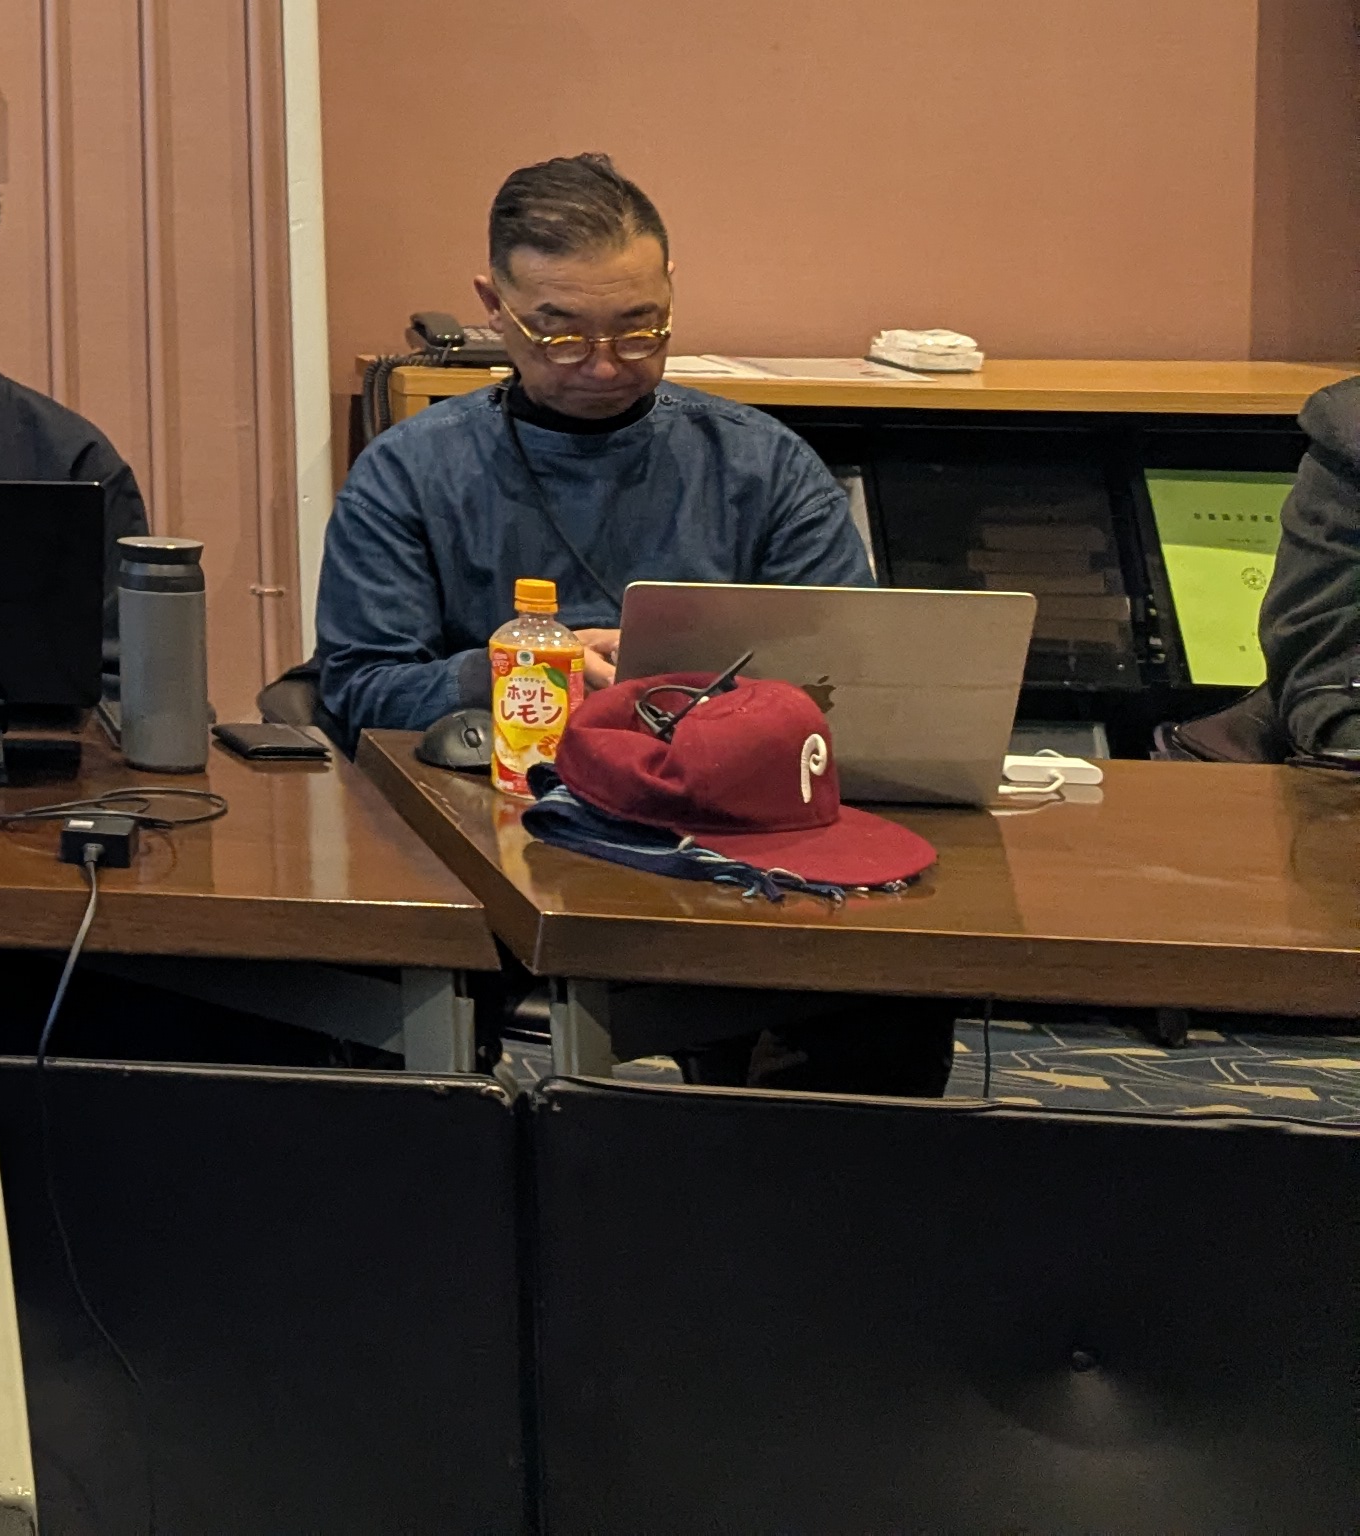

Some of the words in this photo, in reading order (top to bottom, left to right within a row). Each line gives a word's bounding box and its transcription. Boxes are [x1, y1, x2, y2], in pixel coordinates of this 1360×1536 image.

[506, 684, 553, 703] ホット
[500, 700, 562, 724] レモン
